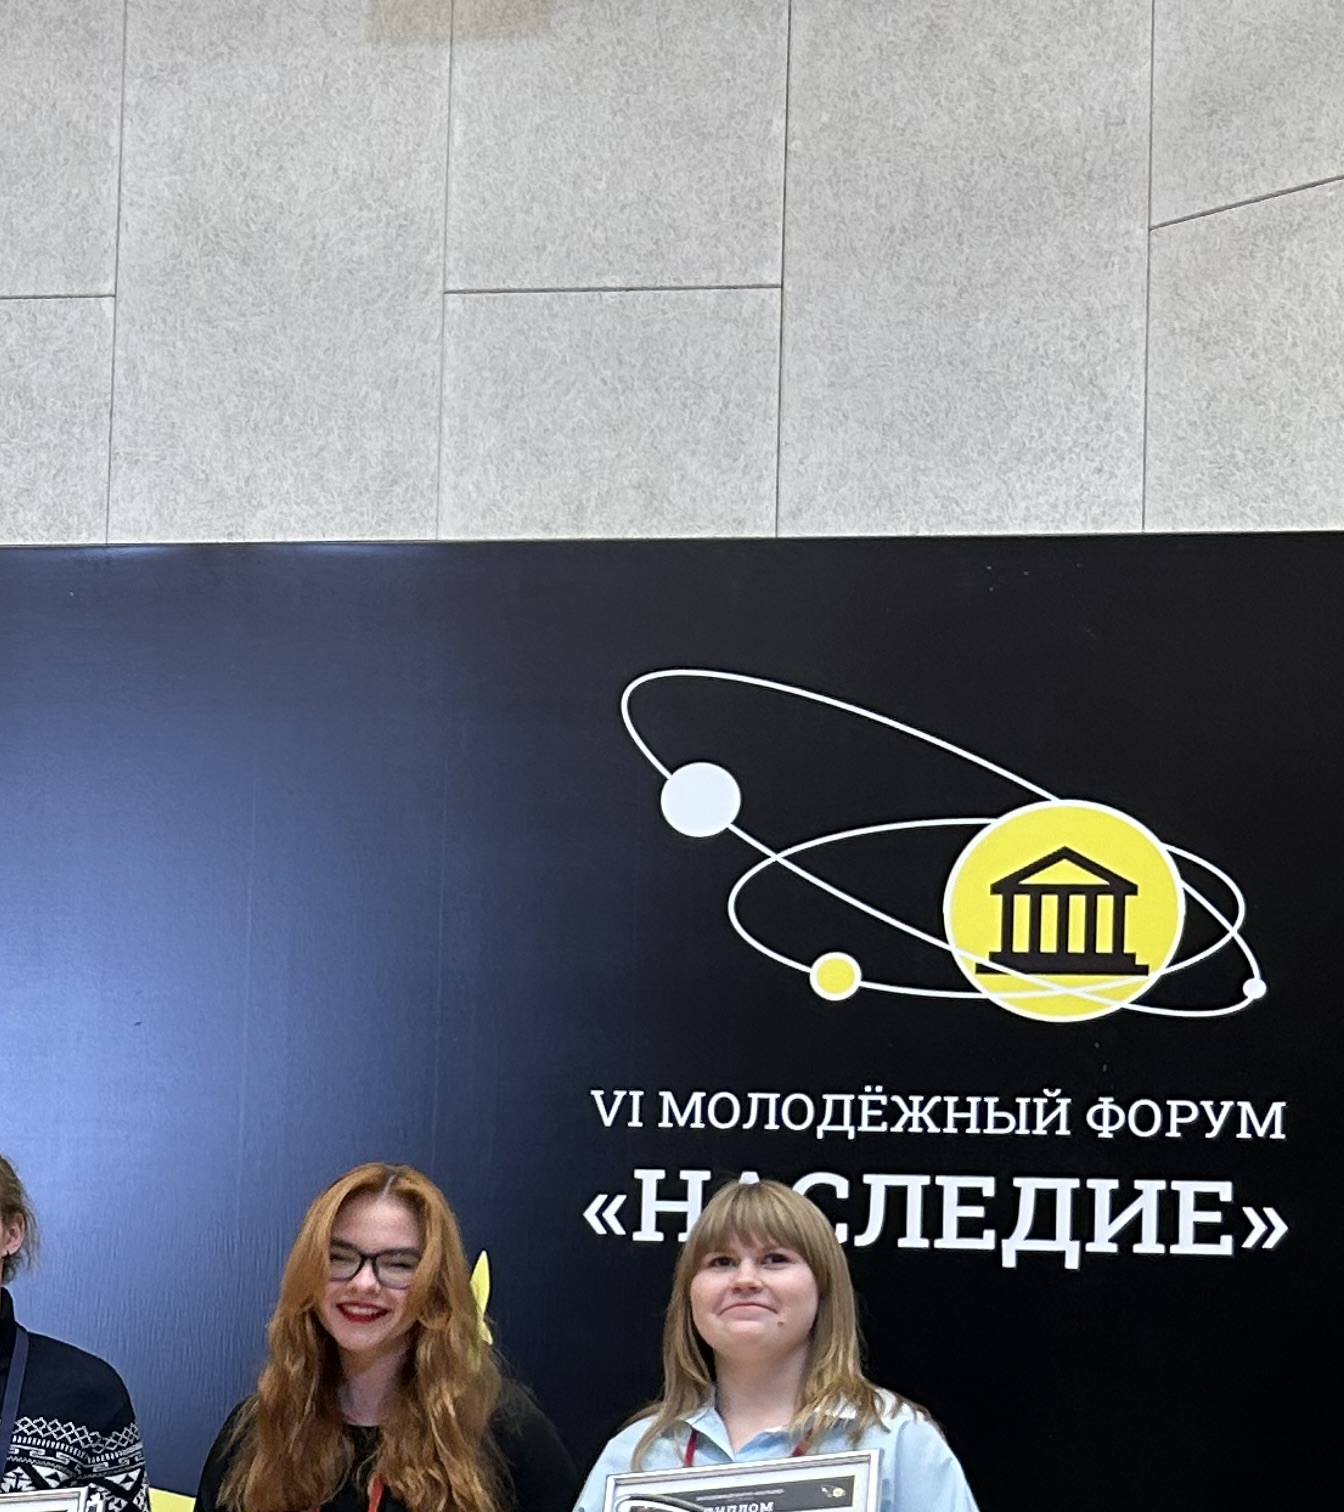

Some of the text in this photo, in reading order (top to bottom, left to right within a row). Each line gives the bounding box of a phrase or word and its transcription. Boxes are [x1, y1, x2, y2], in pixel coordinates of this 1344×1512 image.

[657, 1084, 1073, 1140] МОЛОДЁЖНЫЙ
[1085, 1095, 1288, 1141] ФОРУМ
[582, 1168, 1290, 1271] «НСЛЕДИЕ»
